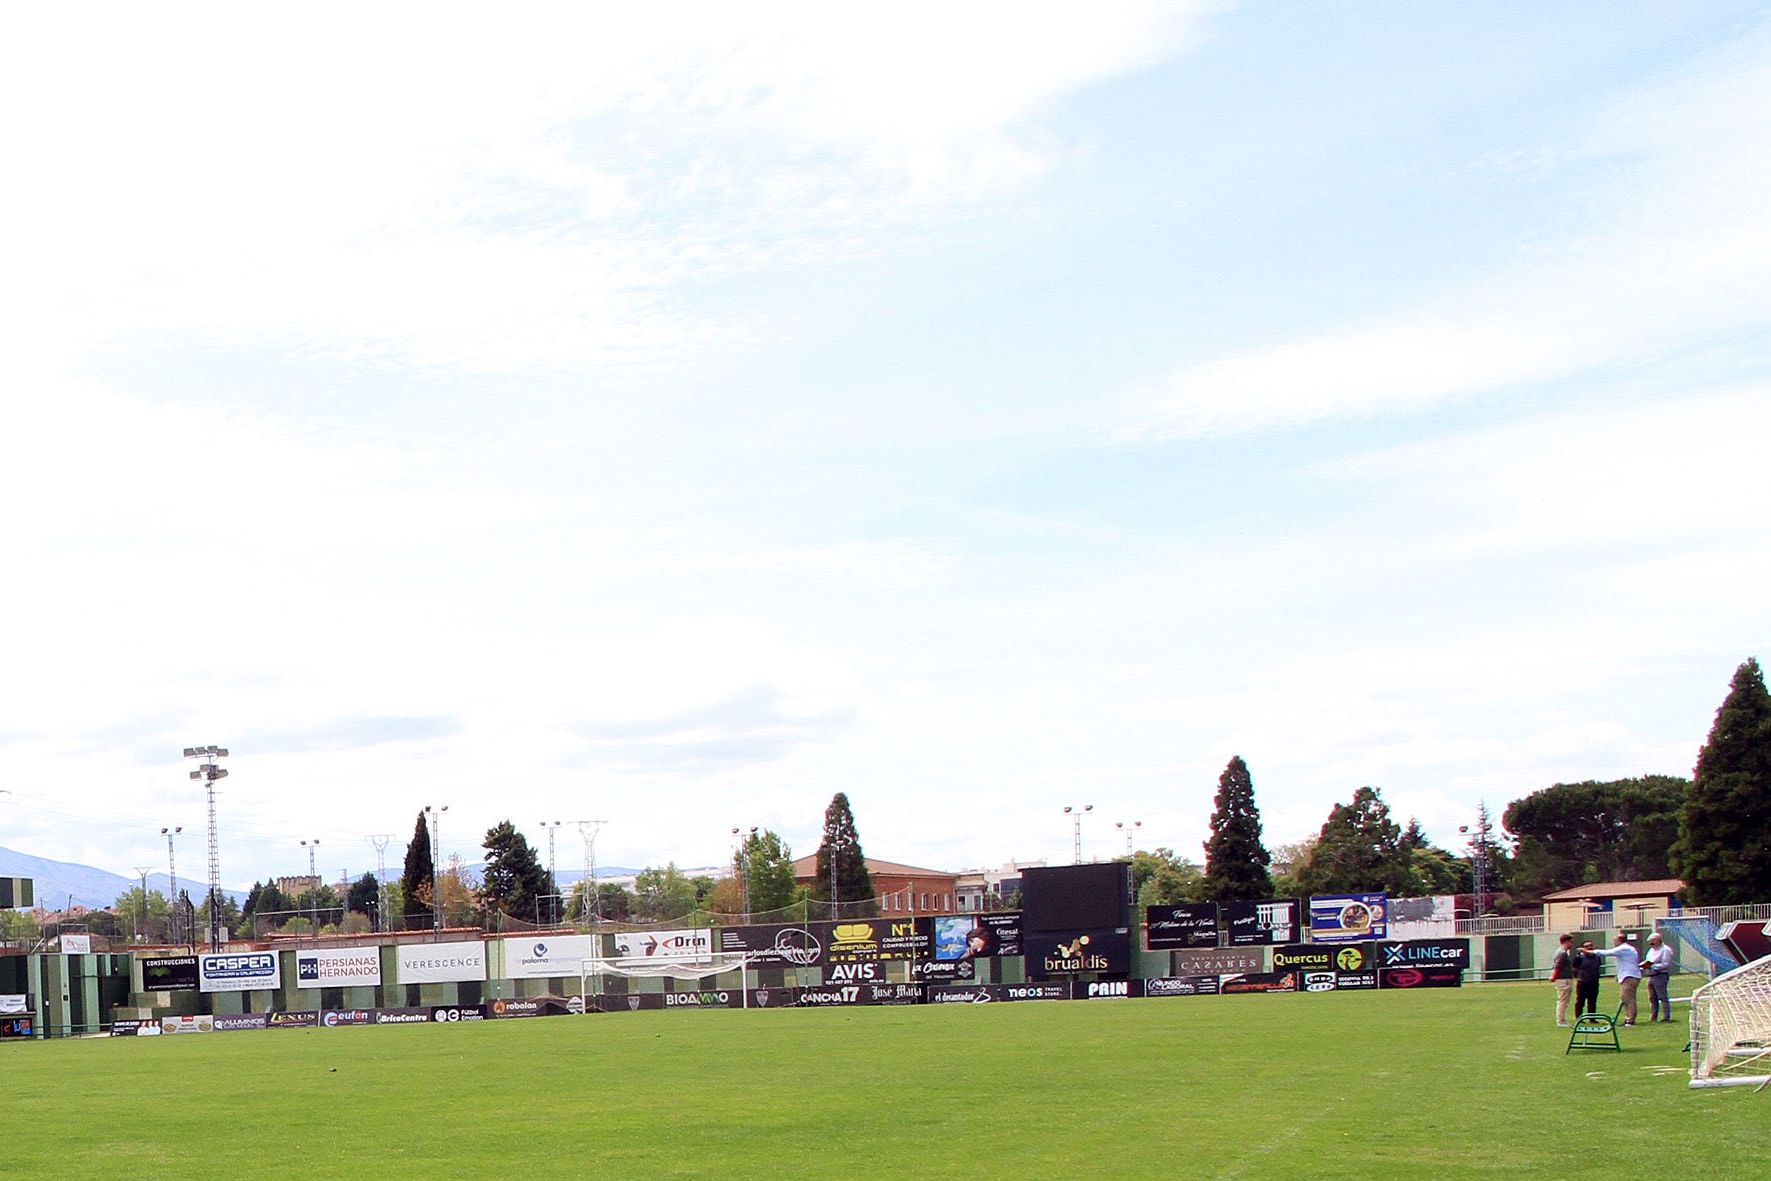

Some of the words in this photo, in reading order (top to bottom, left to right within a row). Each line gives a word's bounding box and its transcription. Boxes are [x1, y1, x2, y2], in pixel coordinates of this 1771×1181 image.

[1408, 946, 1464, 960] LINEcar
[146, 958, 196, 967] CONSTRUCCIONES
[205, 956, 271, 970] CASPER
[319, 956, 377, 968] PERSIANAS
[404, 957, 480, 969] VERESCENCE
[1044, 954, 1108, 970] brualdis
[1274, 953, 1328, 966] Quercus
[300, 963, 317, 974] PH
[319, 966, 379, 977] HERNANDO
[831, 963, 875, 980] AVIS
[1008, 988, 1042, 997] neos
[506, 1001, 537, 1010] robalan
[380, 1013, 427, 1022] BricoCentro
